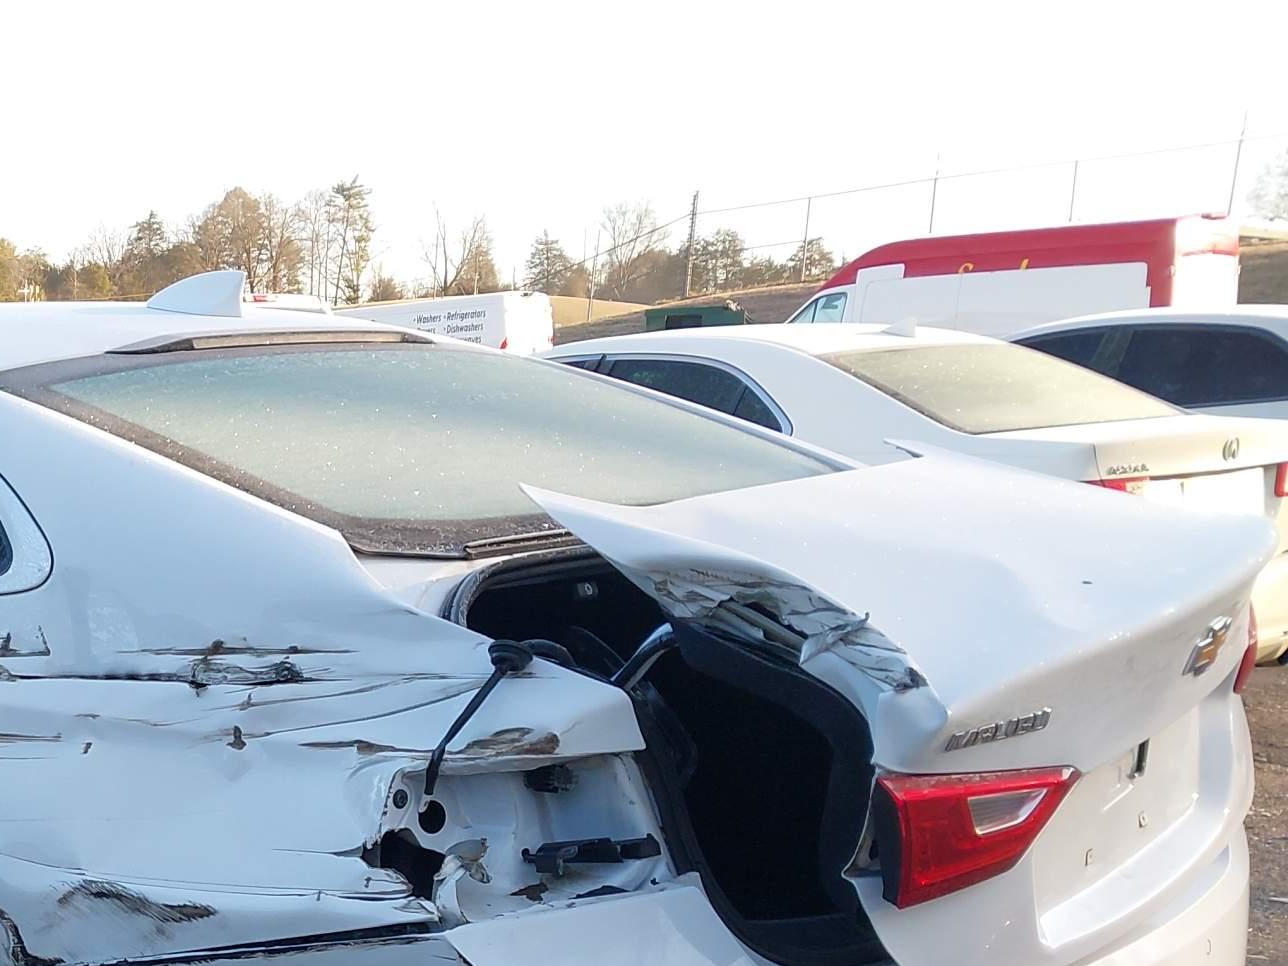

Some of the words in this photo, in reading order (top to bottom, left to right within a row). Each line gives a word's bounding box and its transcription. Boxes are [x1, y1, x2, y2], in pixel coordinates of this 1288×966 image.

[416, 313, 442, 324] Washers
[446, 309, 487, 321] Refrigerators
[446, 323, 484, 334] Dishwashers
